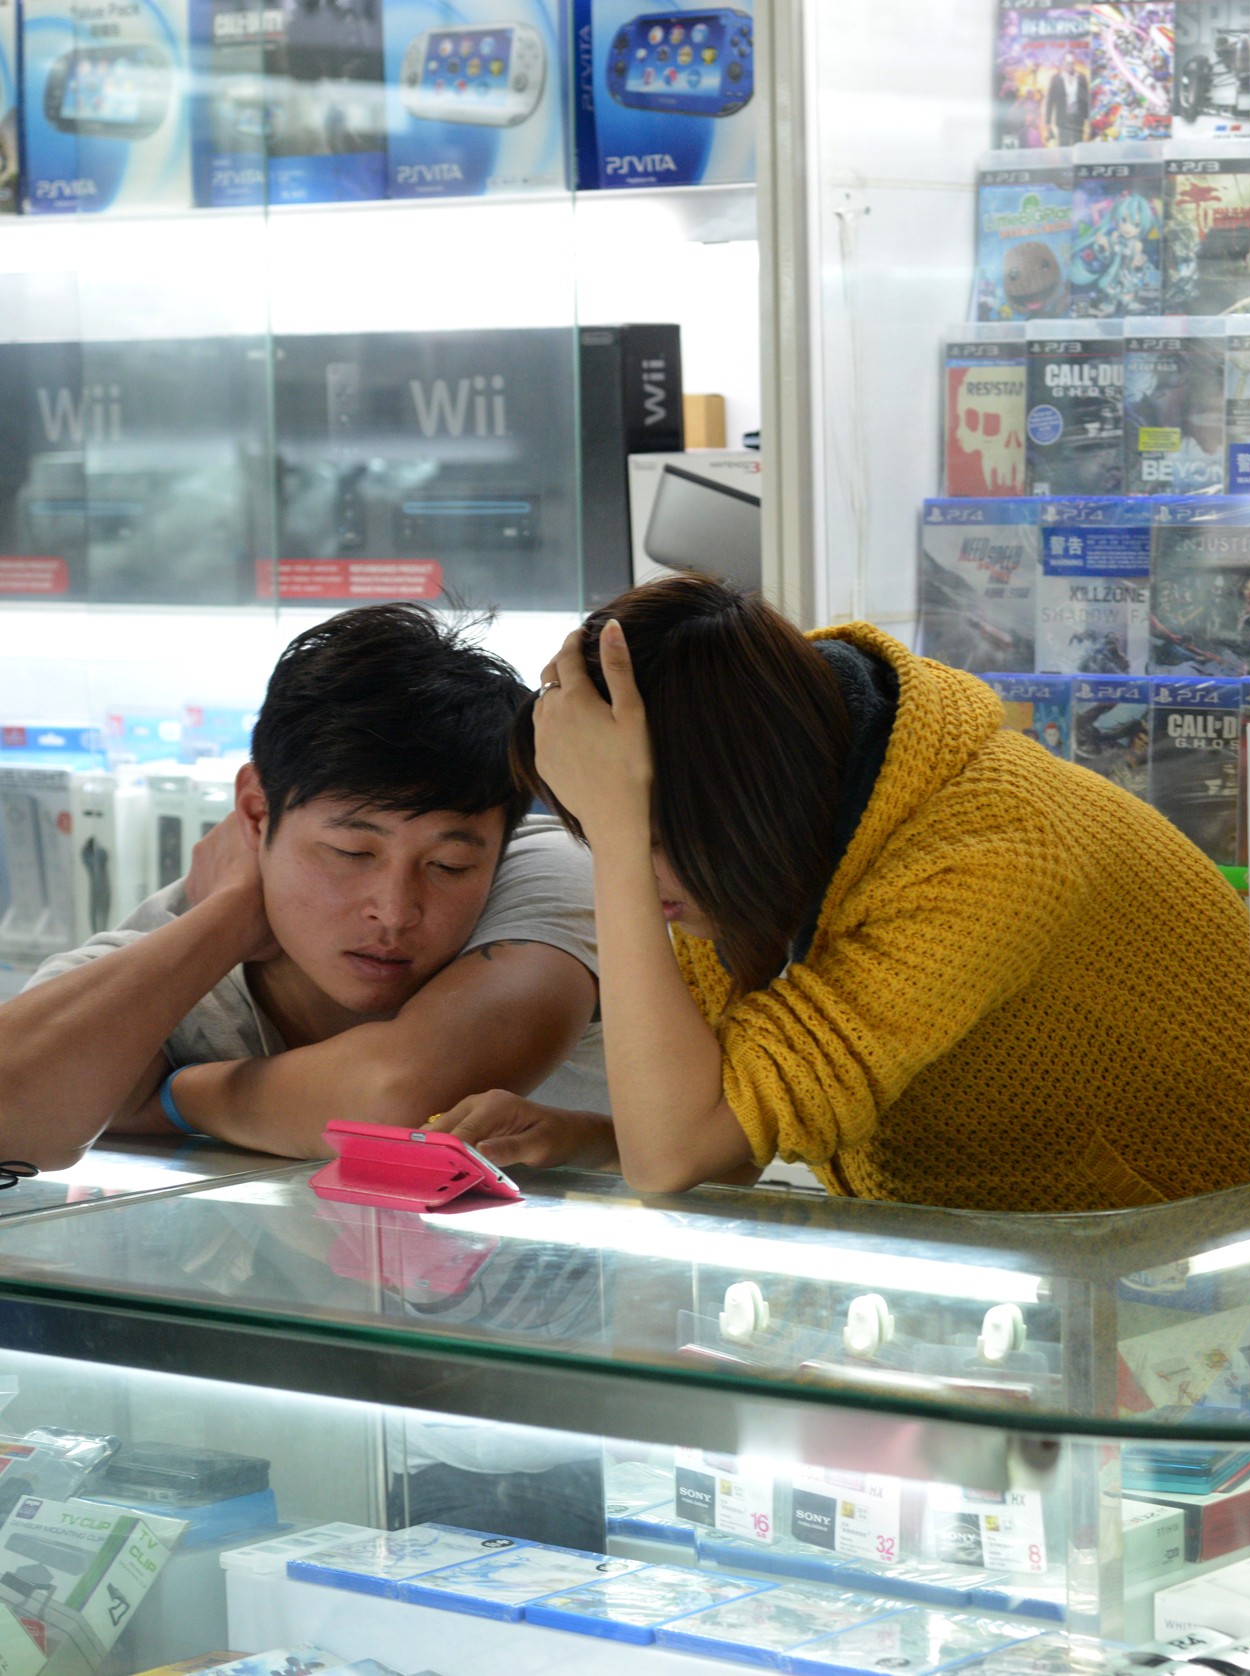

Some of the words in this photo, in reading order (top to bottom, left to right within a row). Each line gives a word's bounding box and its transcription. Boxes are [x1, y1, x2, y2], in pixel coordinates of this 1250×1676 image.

[606, 153, 677, 175] PSVITA
[1092, 165, 1130, 177] PS3
[1182, 161, 1221, 173] PS3
[1044, 342, 1082, 353] PS3
[1044, 363, 1093, 387] CALL
[641, 358, 667, 427] Wii
[37, 384, 122, 443] Wii
[408, 374, 507, 438] Wii
[946, 509, 985, 521] PS4
[1069, 586, 1147, 603] KILLZONE
[1041, 608, 1120, 623] SHADOW
[1010, 685, 1051, 698] PS4
[1099, 686, 1140, 699] PS4
[1177, 689, 1220, 703] PS4
[1167, 713, 1212, 739] CALL
[679, 1486, 712, 1503] SONY
[1010, 1492, 1026, 1507] HX
[61, 1512, 81, 1525] TV
[80, 1517, 112, 1530] CLIP
[750, 1512, 770, 1533] 16
[795, 1508, 832, 1526] SONY
[140, 1528, 159, 1550] TV
[875, 1534, 896, 1556] 32
[127, 1545, 158, 1574] CLIP
[1027, 1543, 1042, 1564] 8
